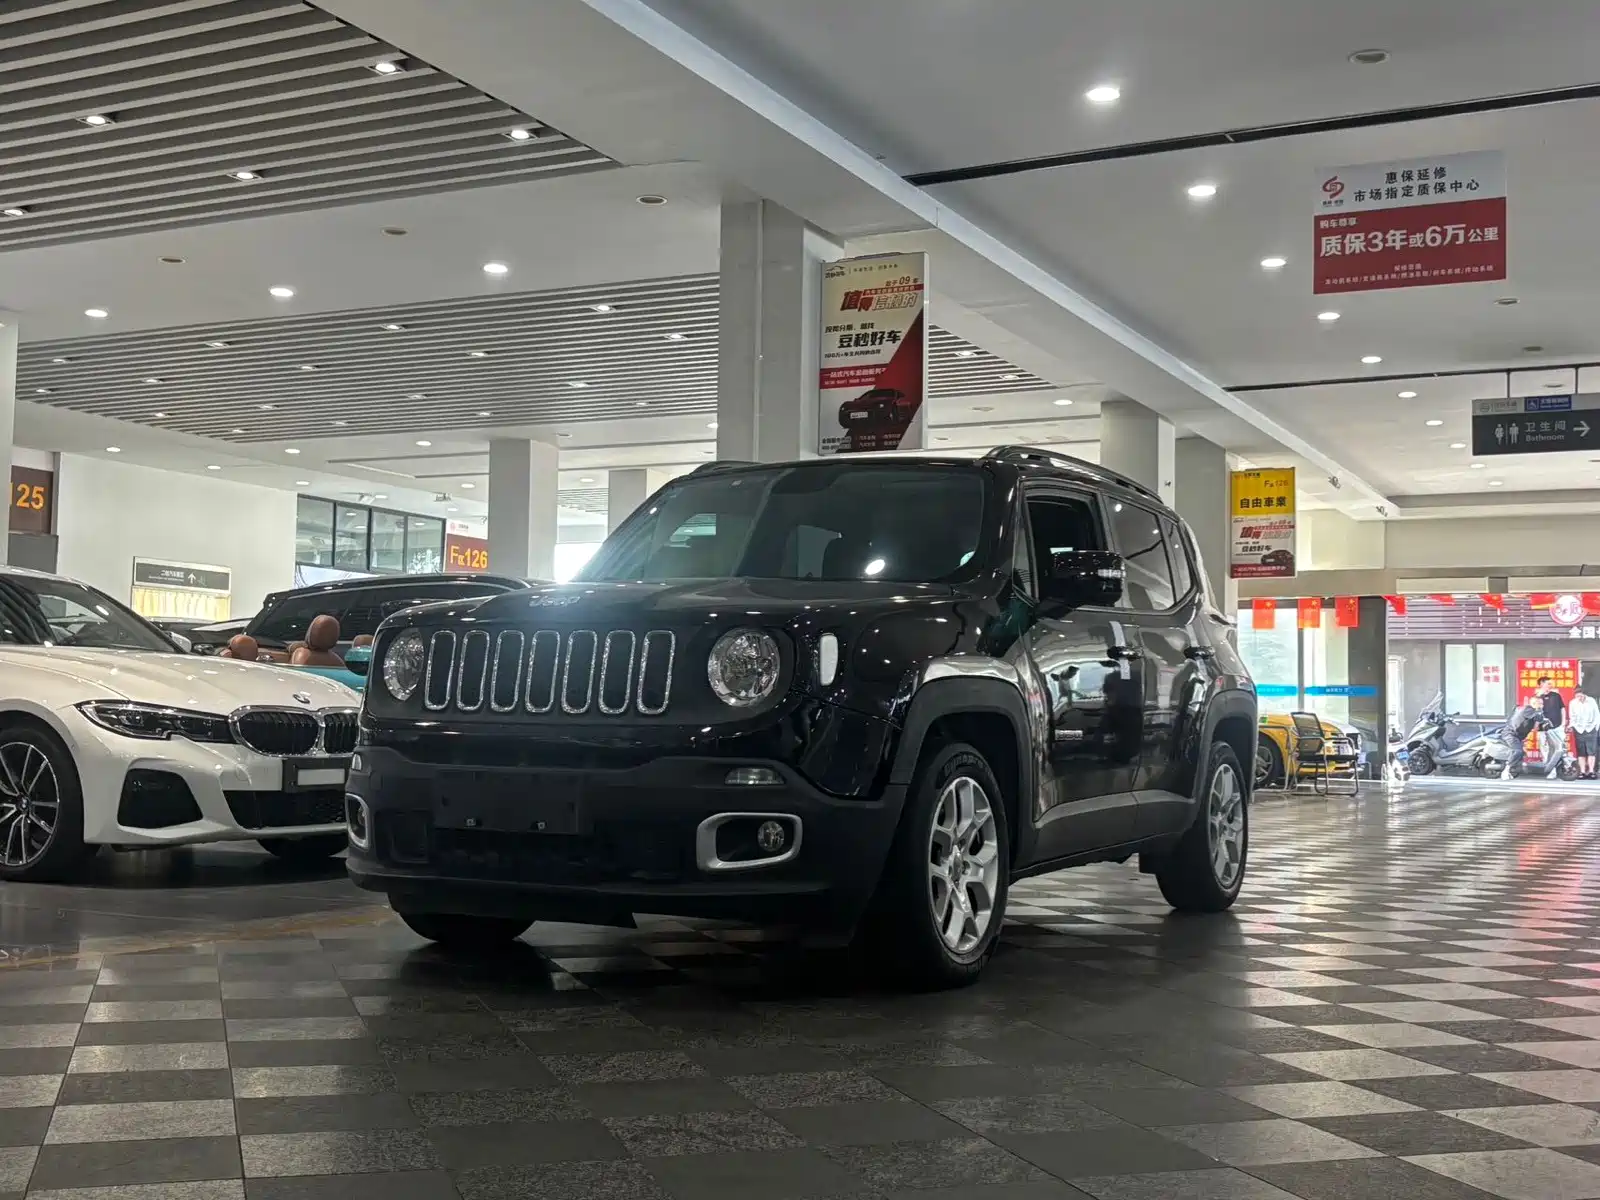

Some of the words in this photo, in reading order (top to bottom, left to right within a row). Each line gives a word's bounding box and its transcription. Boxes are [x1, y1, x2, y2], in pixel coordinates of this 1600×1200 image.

[1385, 166, 1447, 184] 惠保延修
[1353, 179, 1480, 203] 市场指定质保中心
[1320, 224, 1499, 257] 质保3年或6万公里
[1524, 420, 1567, 433] 卫生间
[1569, 626, 1600, 639] 全国
